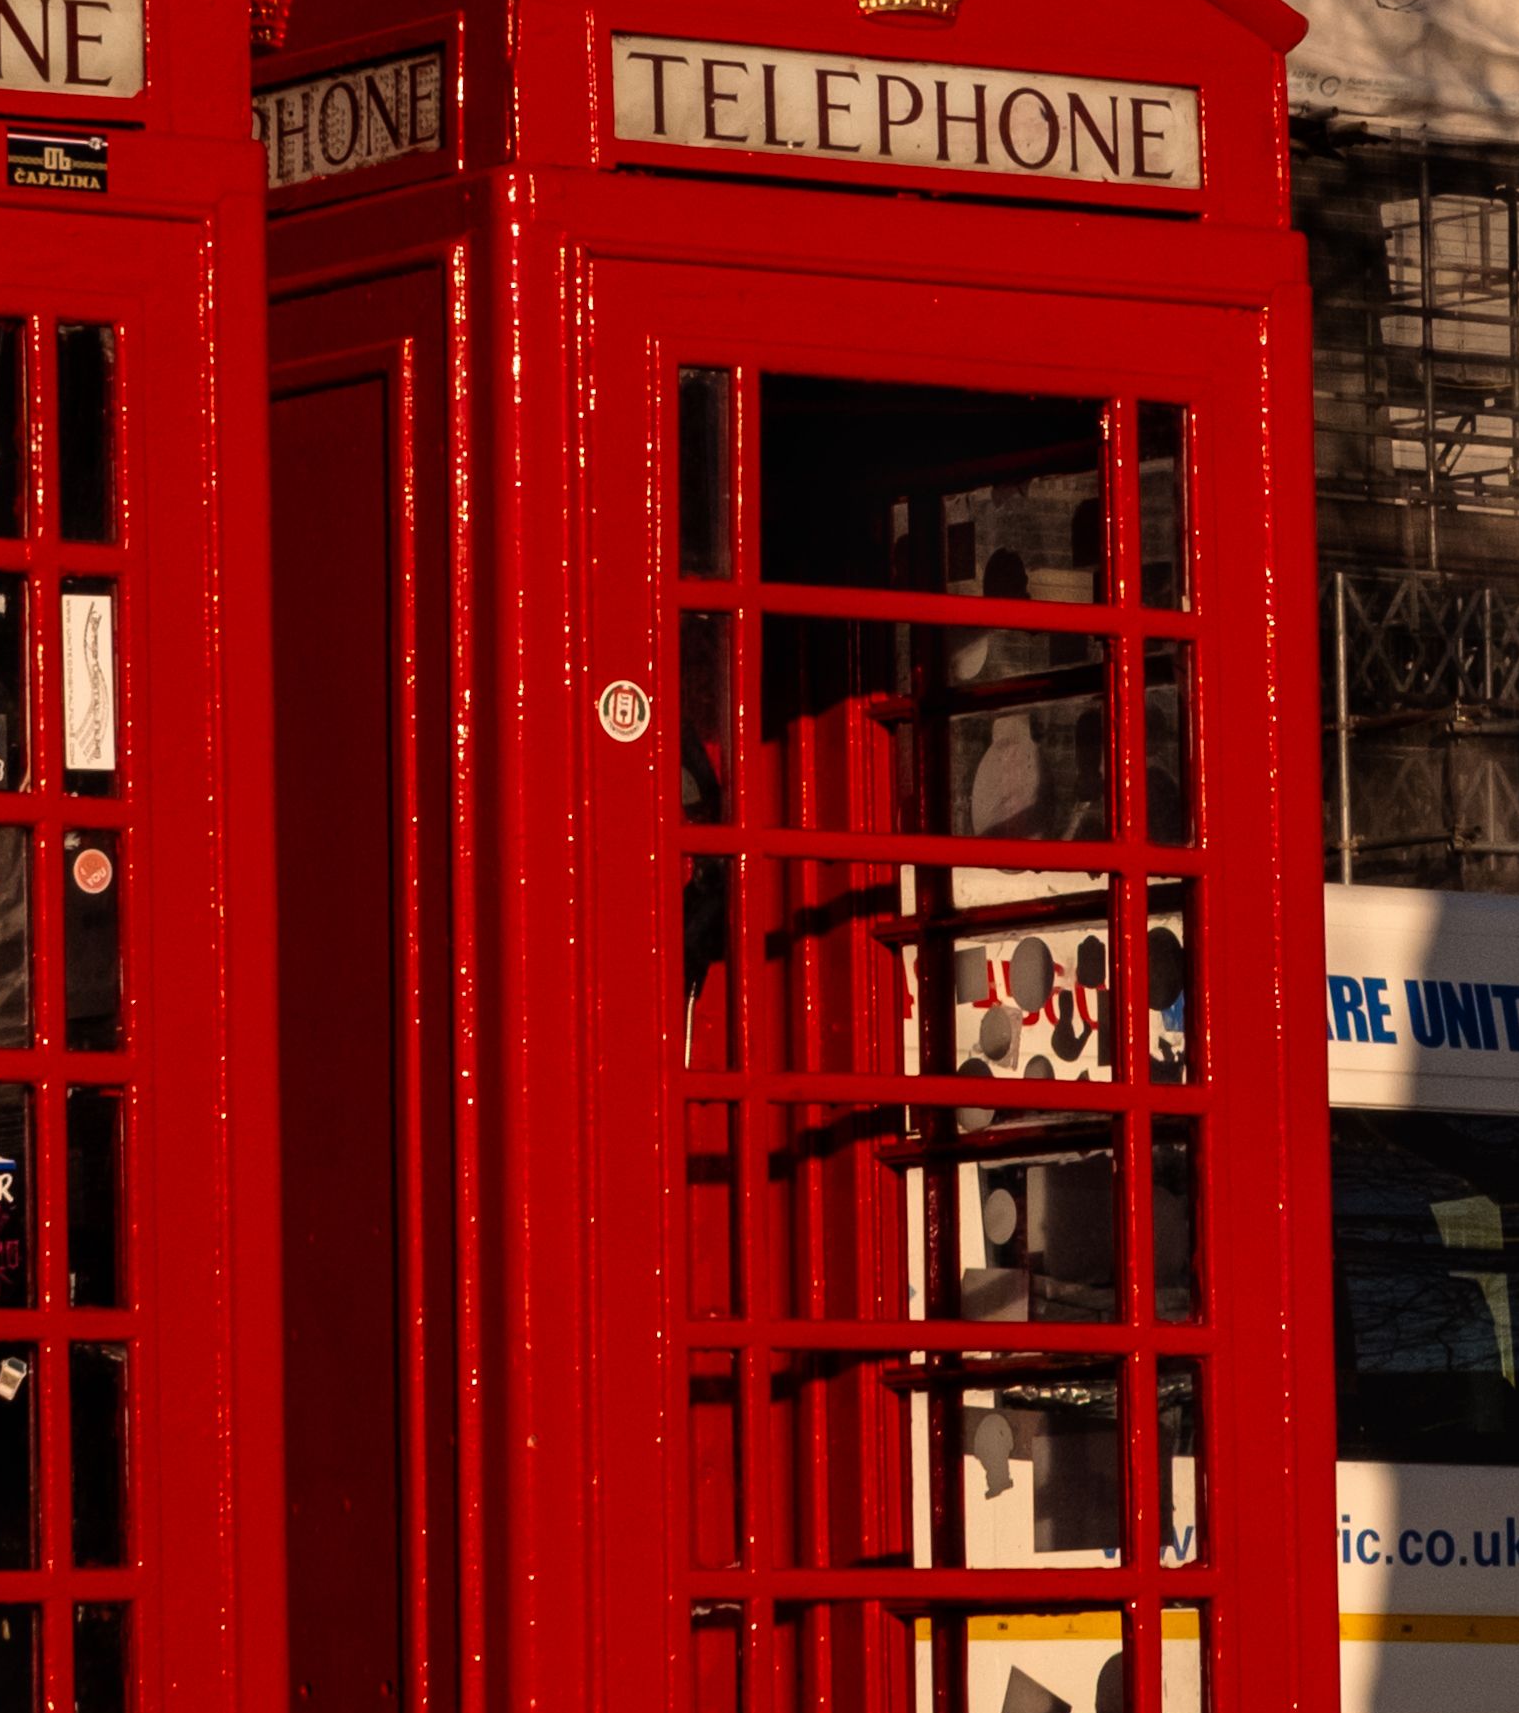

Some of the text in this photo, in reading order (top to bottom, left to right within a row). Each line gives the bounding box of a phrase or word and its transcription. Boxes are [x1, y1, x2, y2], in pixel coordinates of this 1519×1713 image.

[626, 48, 1178, 183] TELEPHONE
[14, 167, 101, 189] ČAPLJINA
[1328, 975, 1398, 1045] RE
